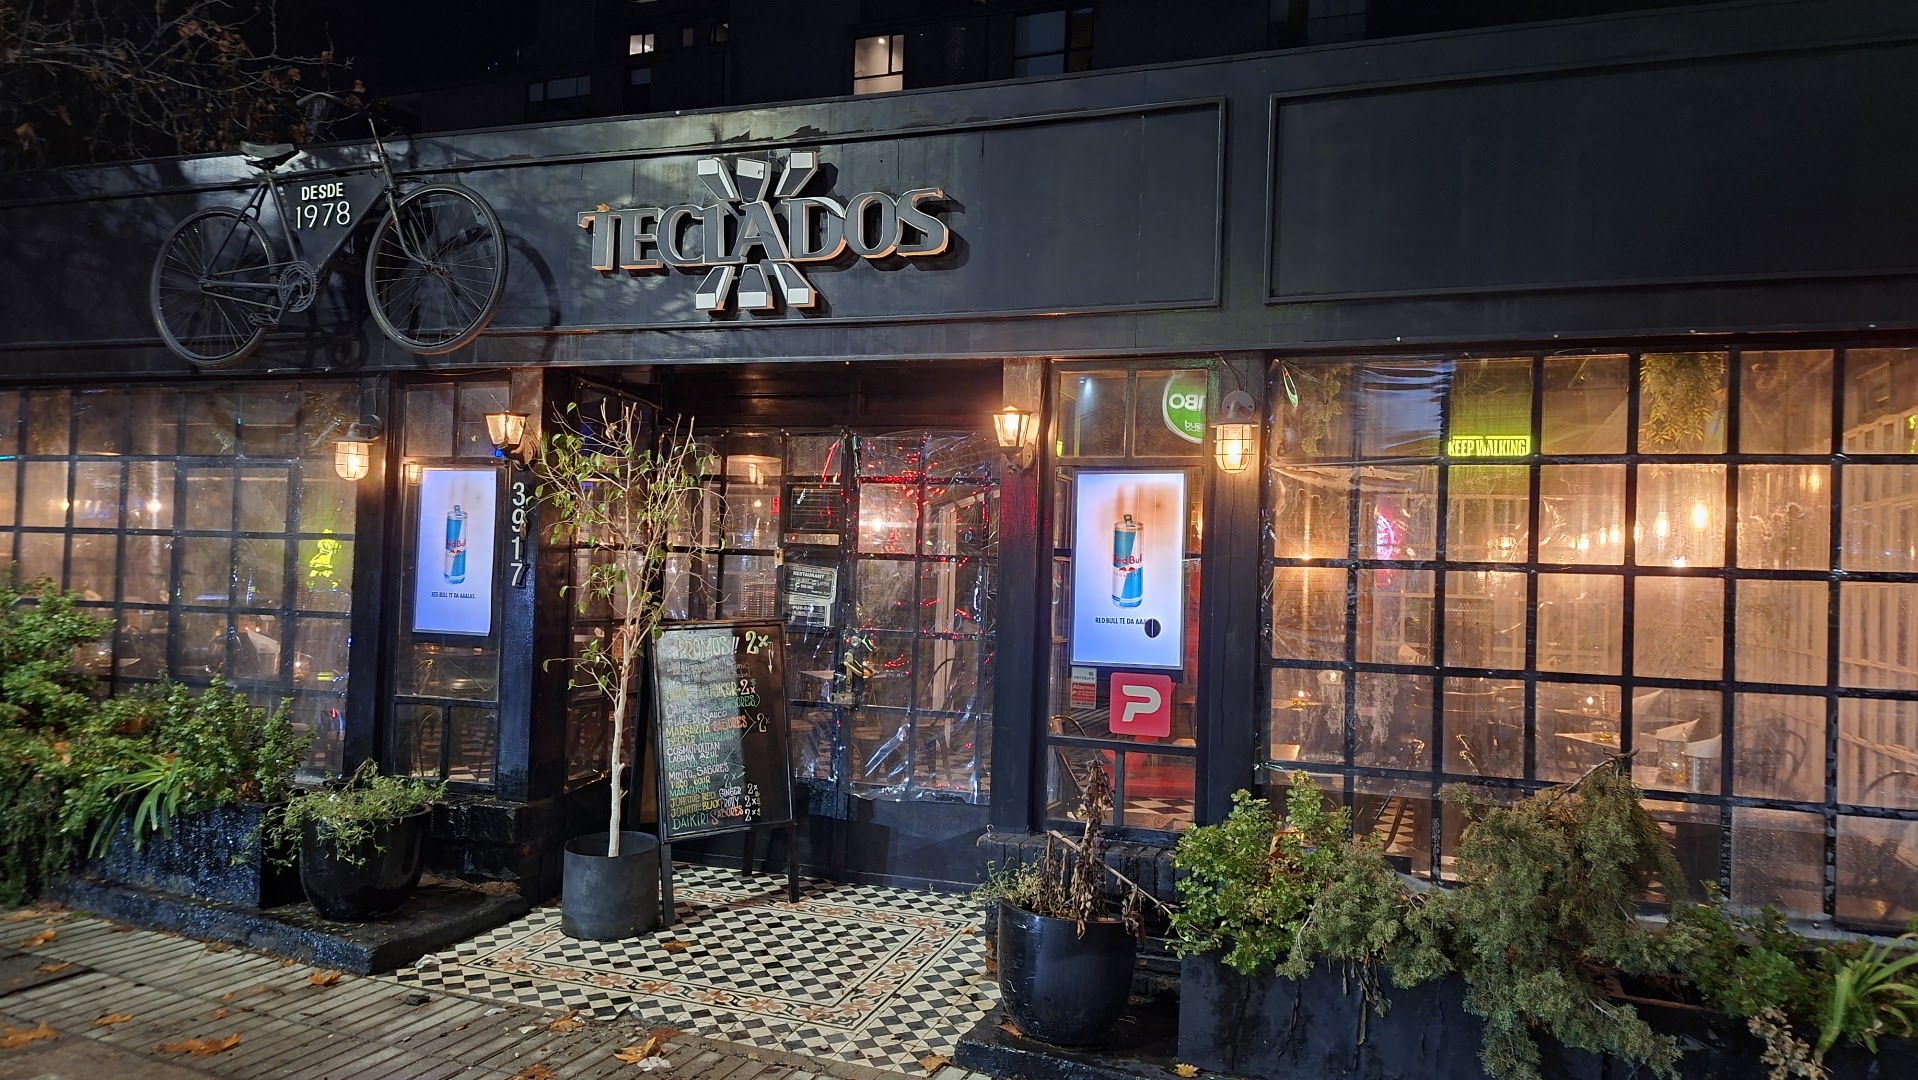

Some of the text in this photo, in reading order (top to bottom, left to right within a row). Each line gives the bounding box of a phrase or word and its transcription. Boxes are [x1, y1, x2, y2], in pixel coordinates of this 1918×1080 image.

[301, 182, 344, 201] DESDE
[296, 200, 351, 229] 1978
[577, 187, 950, 271] TECLADOS
[1447, 439, 1526, 456] KEEP WALKING
[510, 481, 527, 587] 3917
[792, 570, 825, 580] RESTAURANT
[1095, 616, 1106, 624] RED
[1106, 617, 1118, 625] BULL
[1120, 617, 1125, 625] TE
[674, 635, 731, 660] PROMOS
[1072, 683, 1095, 691] Alarma
[702, 711, 728, 725] SAUCO
[665, 715, 748, 738] MARGARITA SABORES
[667, 741, 720, 757] COSMOPOLITAN
[668, 750, 719, 763] LAGUNA AZUL
[697, 762, 729, 777] SABORES
[701, 791, 716, 801] RED
[719, 786, 742, 798] GINGER
[709, 804, 744, 825] SABORES
